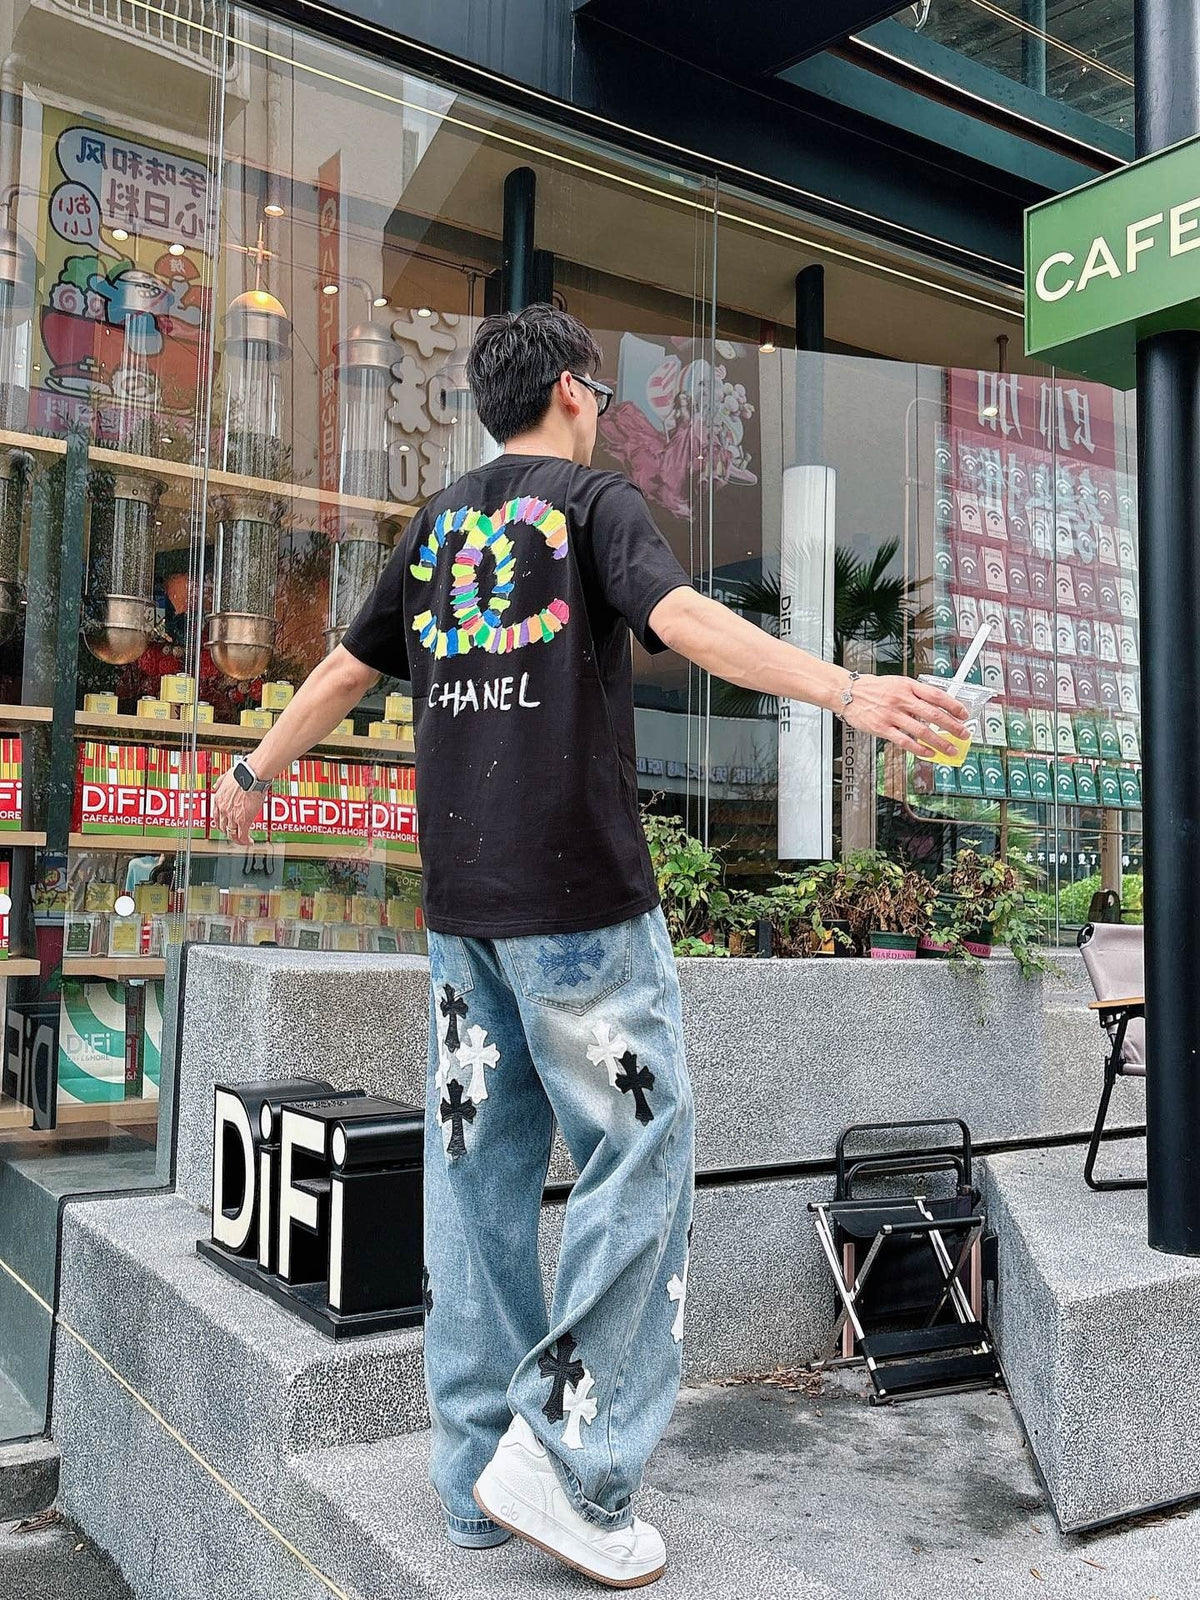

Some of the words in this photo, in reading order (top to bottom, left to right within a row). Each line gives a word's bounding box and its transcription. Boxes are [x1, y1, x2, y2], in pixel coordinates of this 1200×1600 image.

[1035, 197, 1200, 302] CAFE
[780, 595, 792, 637] DiFi
[428, 671, 541, 718] CHANEL
[845, 745, 855, 802] COFFEE
[82, 785, 145, 816] DiFi
[145, 788, 207, 818] DiFi
[271, 796, 323, 824] DiFi
[322, 800, 369, 828] DiFi
[82, 813, 144, 825] CAFE&MORE
[271, 822, 323, 833] CAFE&MORE
[322, 826, 368, 837] CAFE&MORE
[372, 804, 418, 834] DiFi
[372, 829, 416, 842] CAFE&MORE
[66, 1032, 112, 1055] DiFi
[213, 1088, 347, 1310] DiFi
